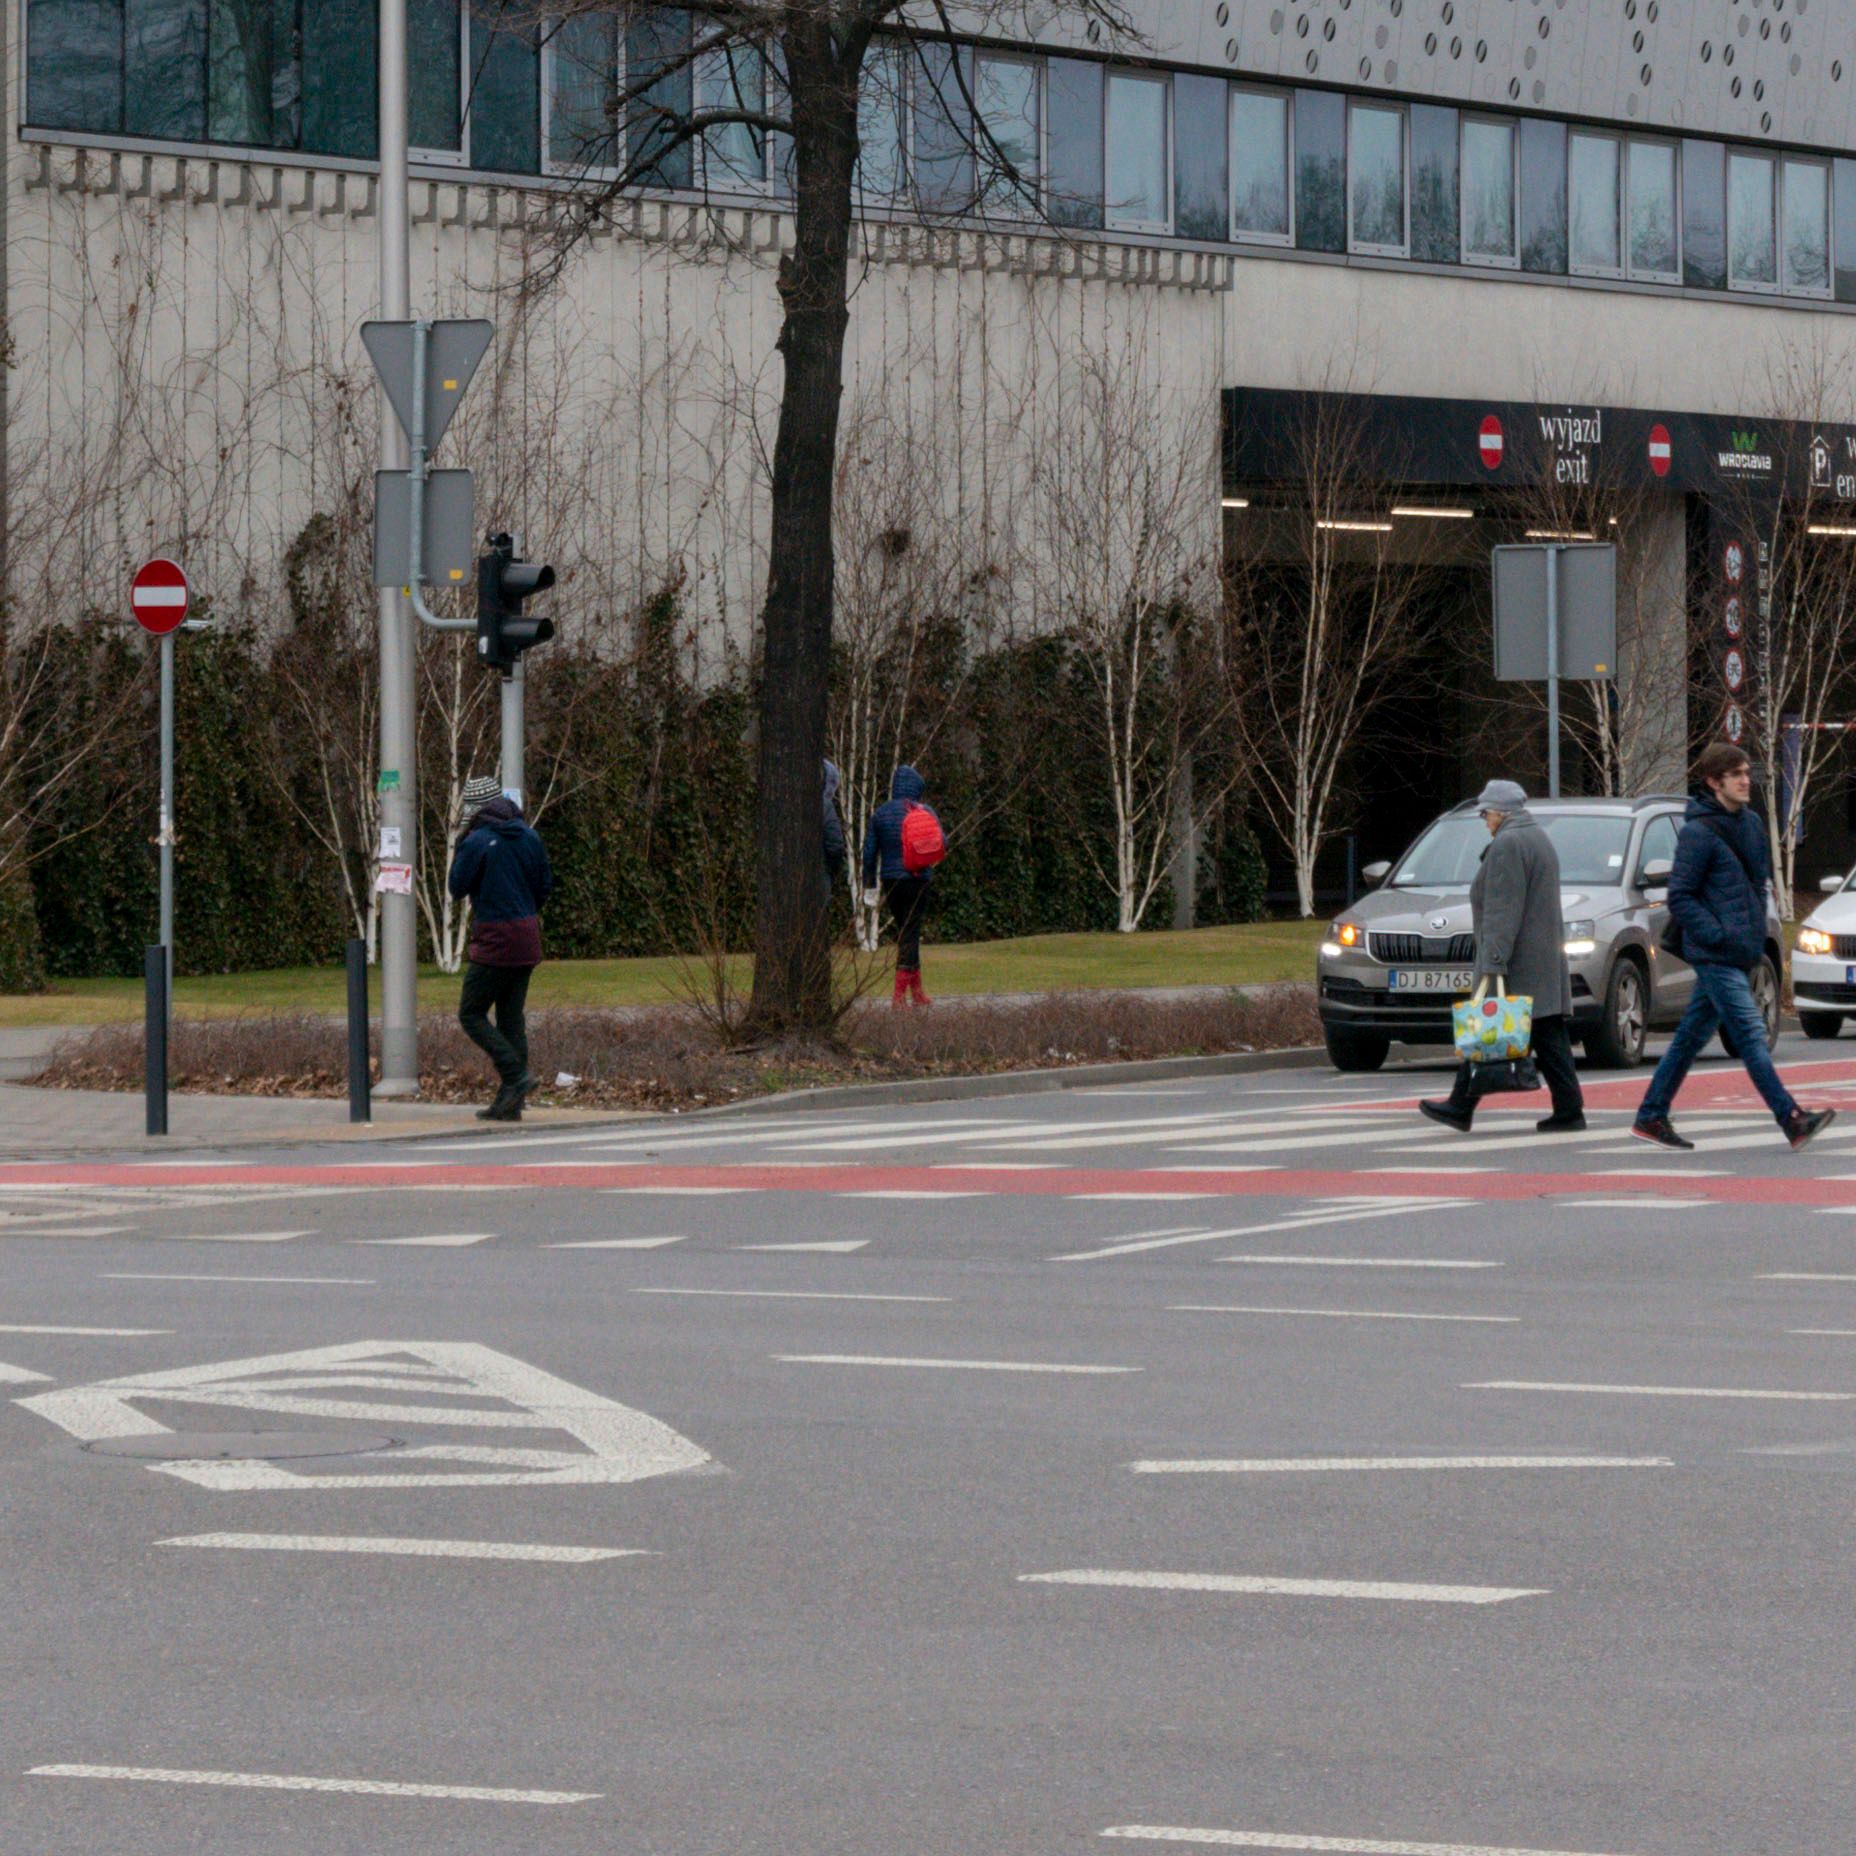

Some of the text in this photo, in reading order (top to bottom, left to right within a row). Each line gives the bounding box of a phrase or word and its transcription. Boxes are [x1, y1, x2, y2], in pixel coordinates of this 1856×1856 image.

[1539, 407, 1601, 452] wyjazd
[1556, 449, 1589, 484] exit
[1398, 972, 1472, 988] DJ 87165
